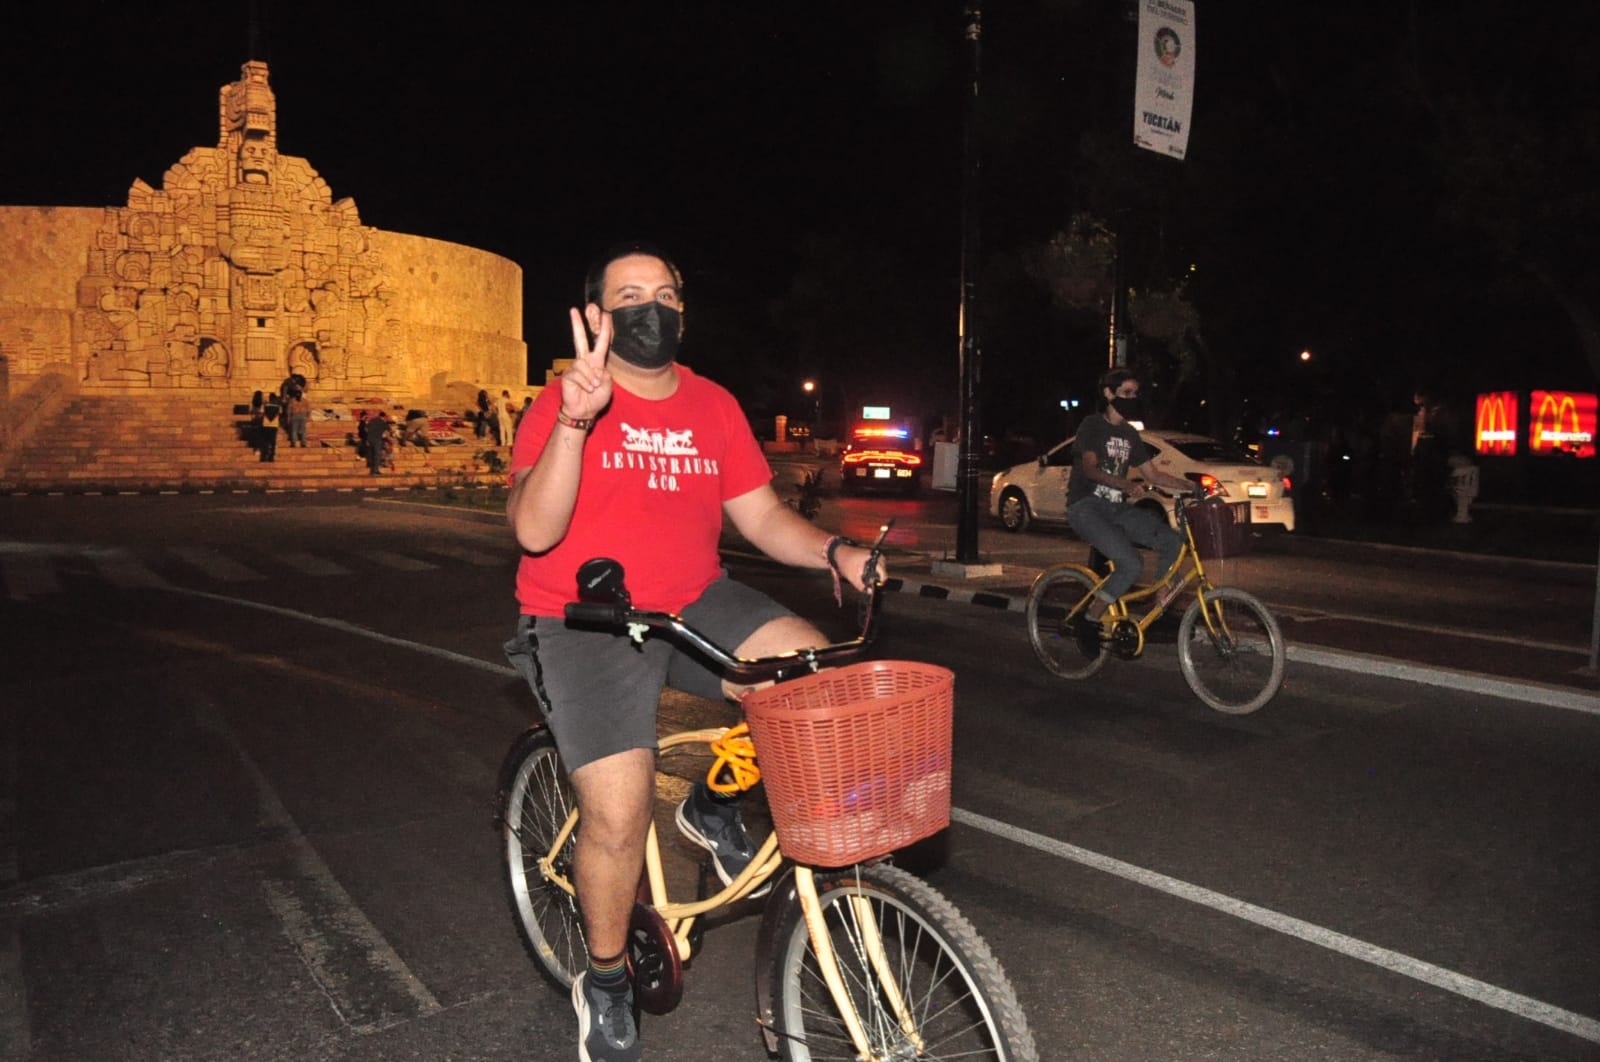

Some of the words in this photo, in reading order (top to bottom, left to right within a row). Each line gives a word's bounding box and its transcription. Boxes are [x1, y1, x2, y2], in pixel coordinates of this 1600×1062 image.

[1142, 111, 1182, 133] YUCATÁN
[601, 450, 645, 470] LEVI
[648, 455, 719, 475] STRAUSS
